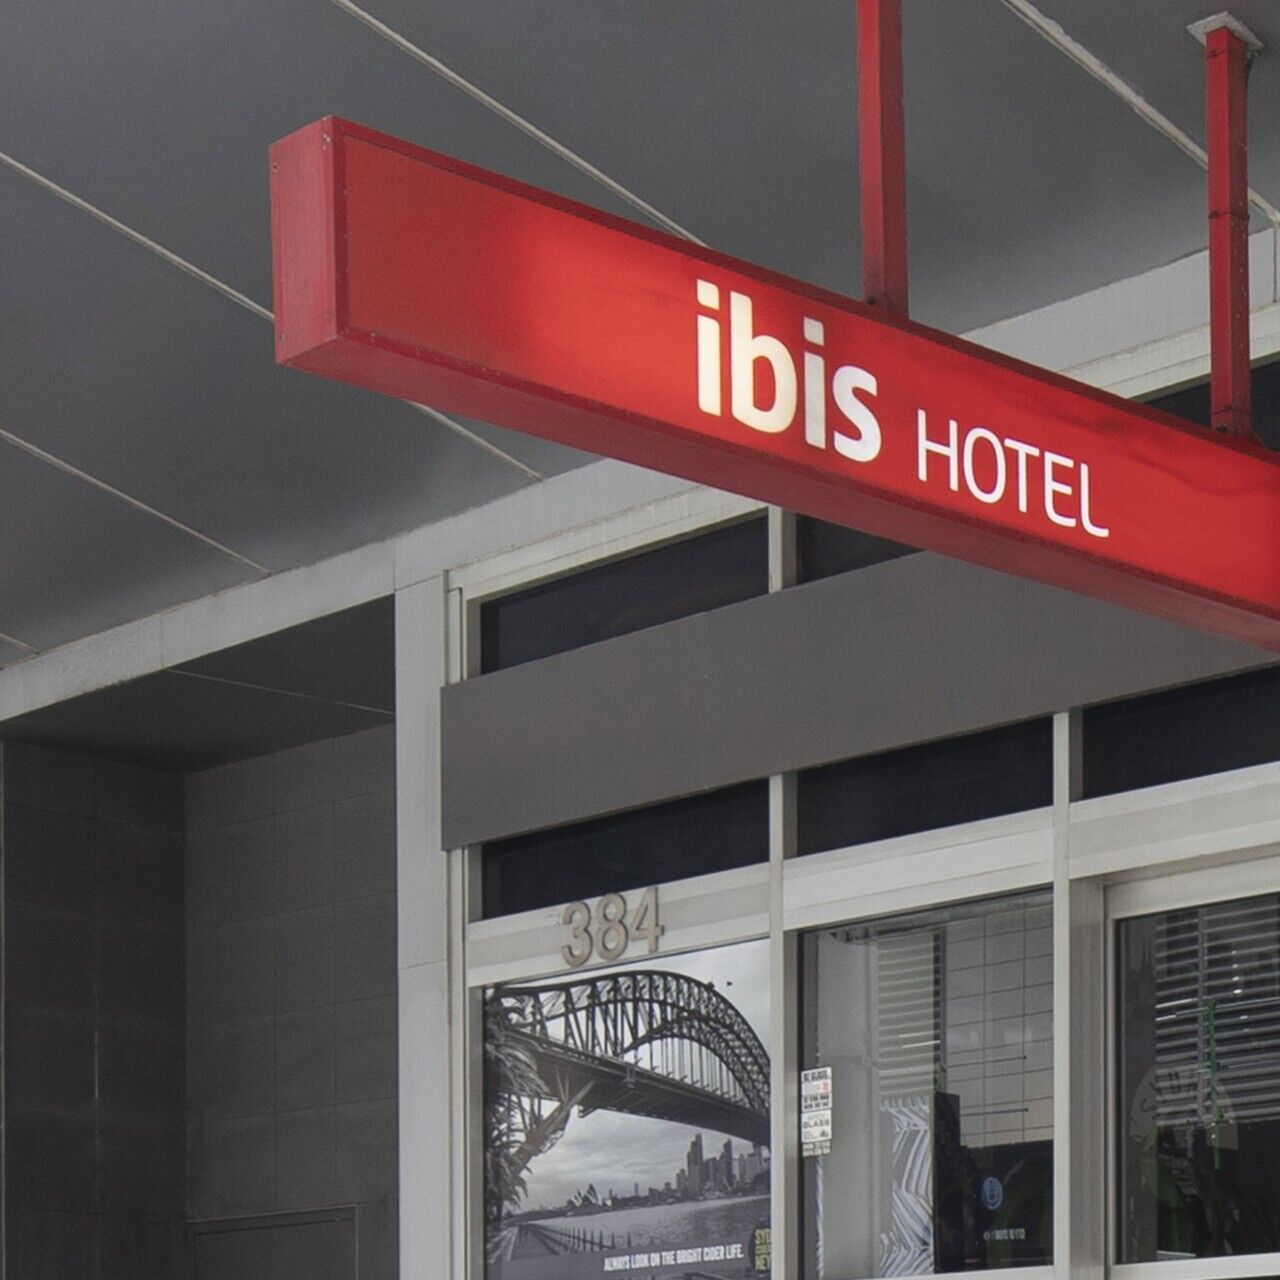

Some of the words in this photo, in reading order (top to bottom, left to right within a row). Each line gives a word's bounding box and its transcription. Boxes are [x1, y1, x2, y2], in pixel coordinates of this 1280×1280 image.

[697, 279, 882, 462] ibis
[917, 409, 1110, 538] HOTEL
[562, 886, 664, 968] 384
